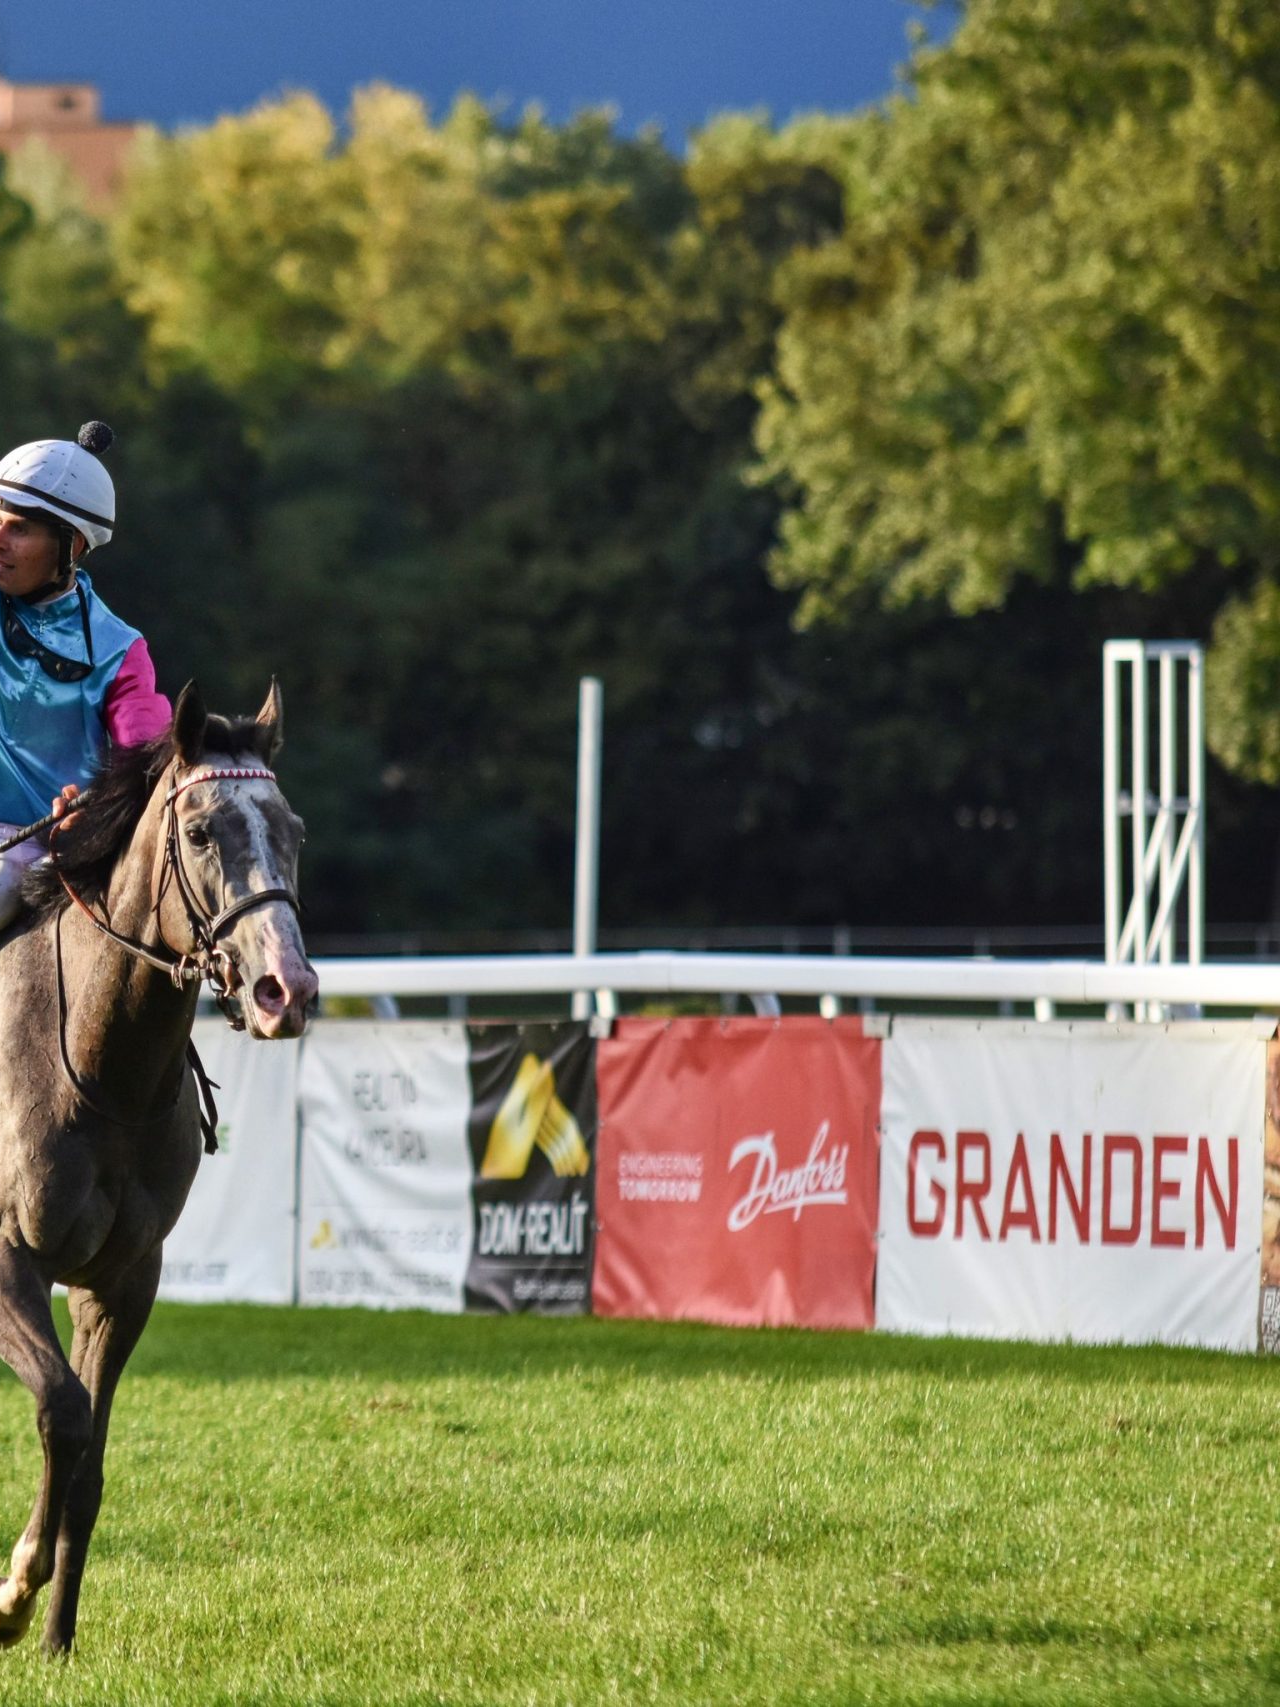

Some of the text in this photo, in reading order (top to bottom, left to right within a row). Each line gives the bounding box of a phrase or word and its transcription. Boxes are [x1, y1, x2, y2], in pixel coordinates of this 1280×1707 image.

[618, 1179, 702, 1202] TOMORROW
[619, 1154, 703, 1177] ENGINEERING
[727, 1119, 849, 1232] Danfoss
[906, 1130, 1239, 1251] GRANDEN
